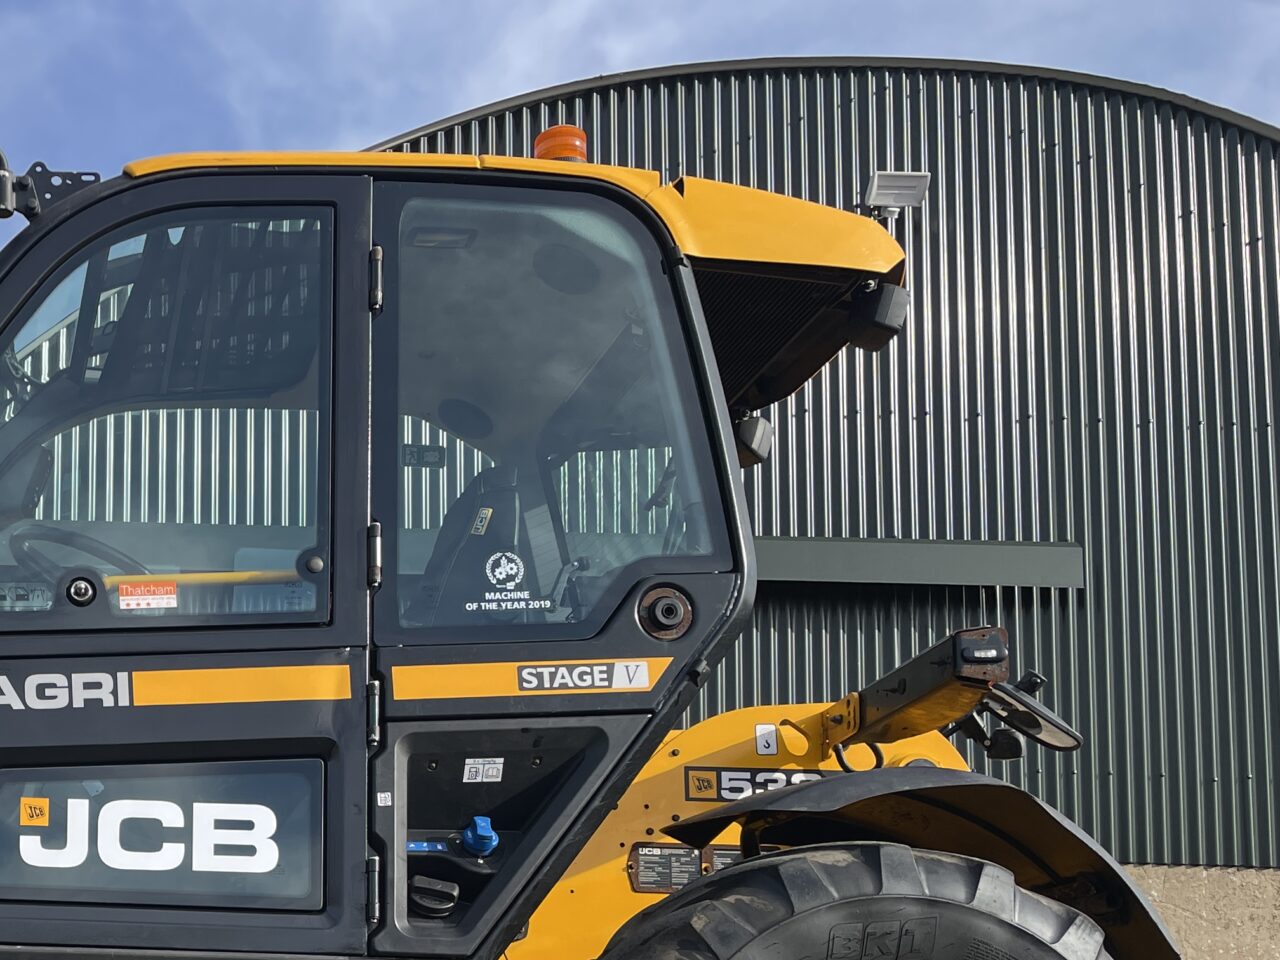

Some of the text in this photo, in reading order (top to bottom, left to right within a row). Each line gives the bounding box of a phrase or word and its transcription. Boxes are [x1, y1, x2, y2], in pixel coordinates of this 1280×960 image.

[473, 510, 488, 533] JCB
[121, 584, 174, 596] Thatcham
[485, 591, 530, 600] MACHINE
[465, 600, 551, 611] OF THE YEAR 2019
[521, 664, 641, 689] STAGE V
[696, 777, 714, 791] JCB
[27, 804, 46, 820] JCB
[19, 798, 279, 874] JCB
